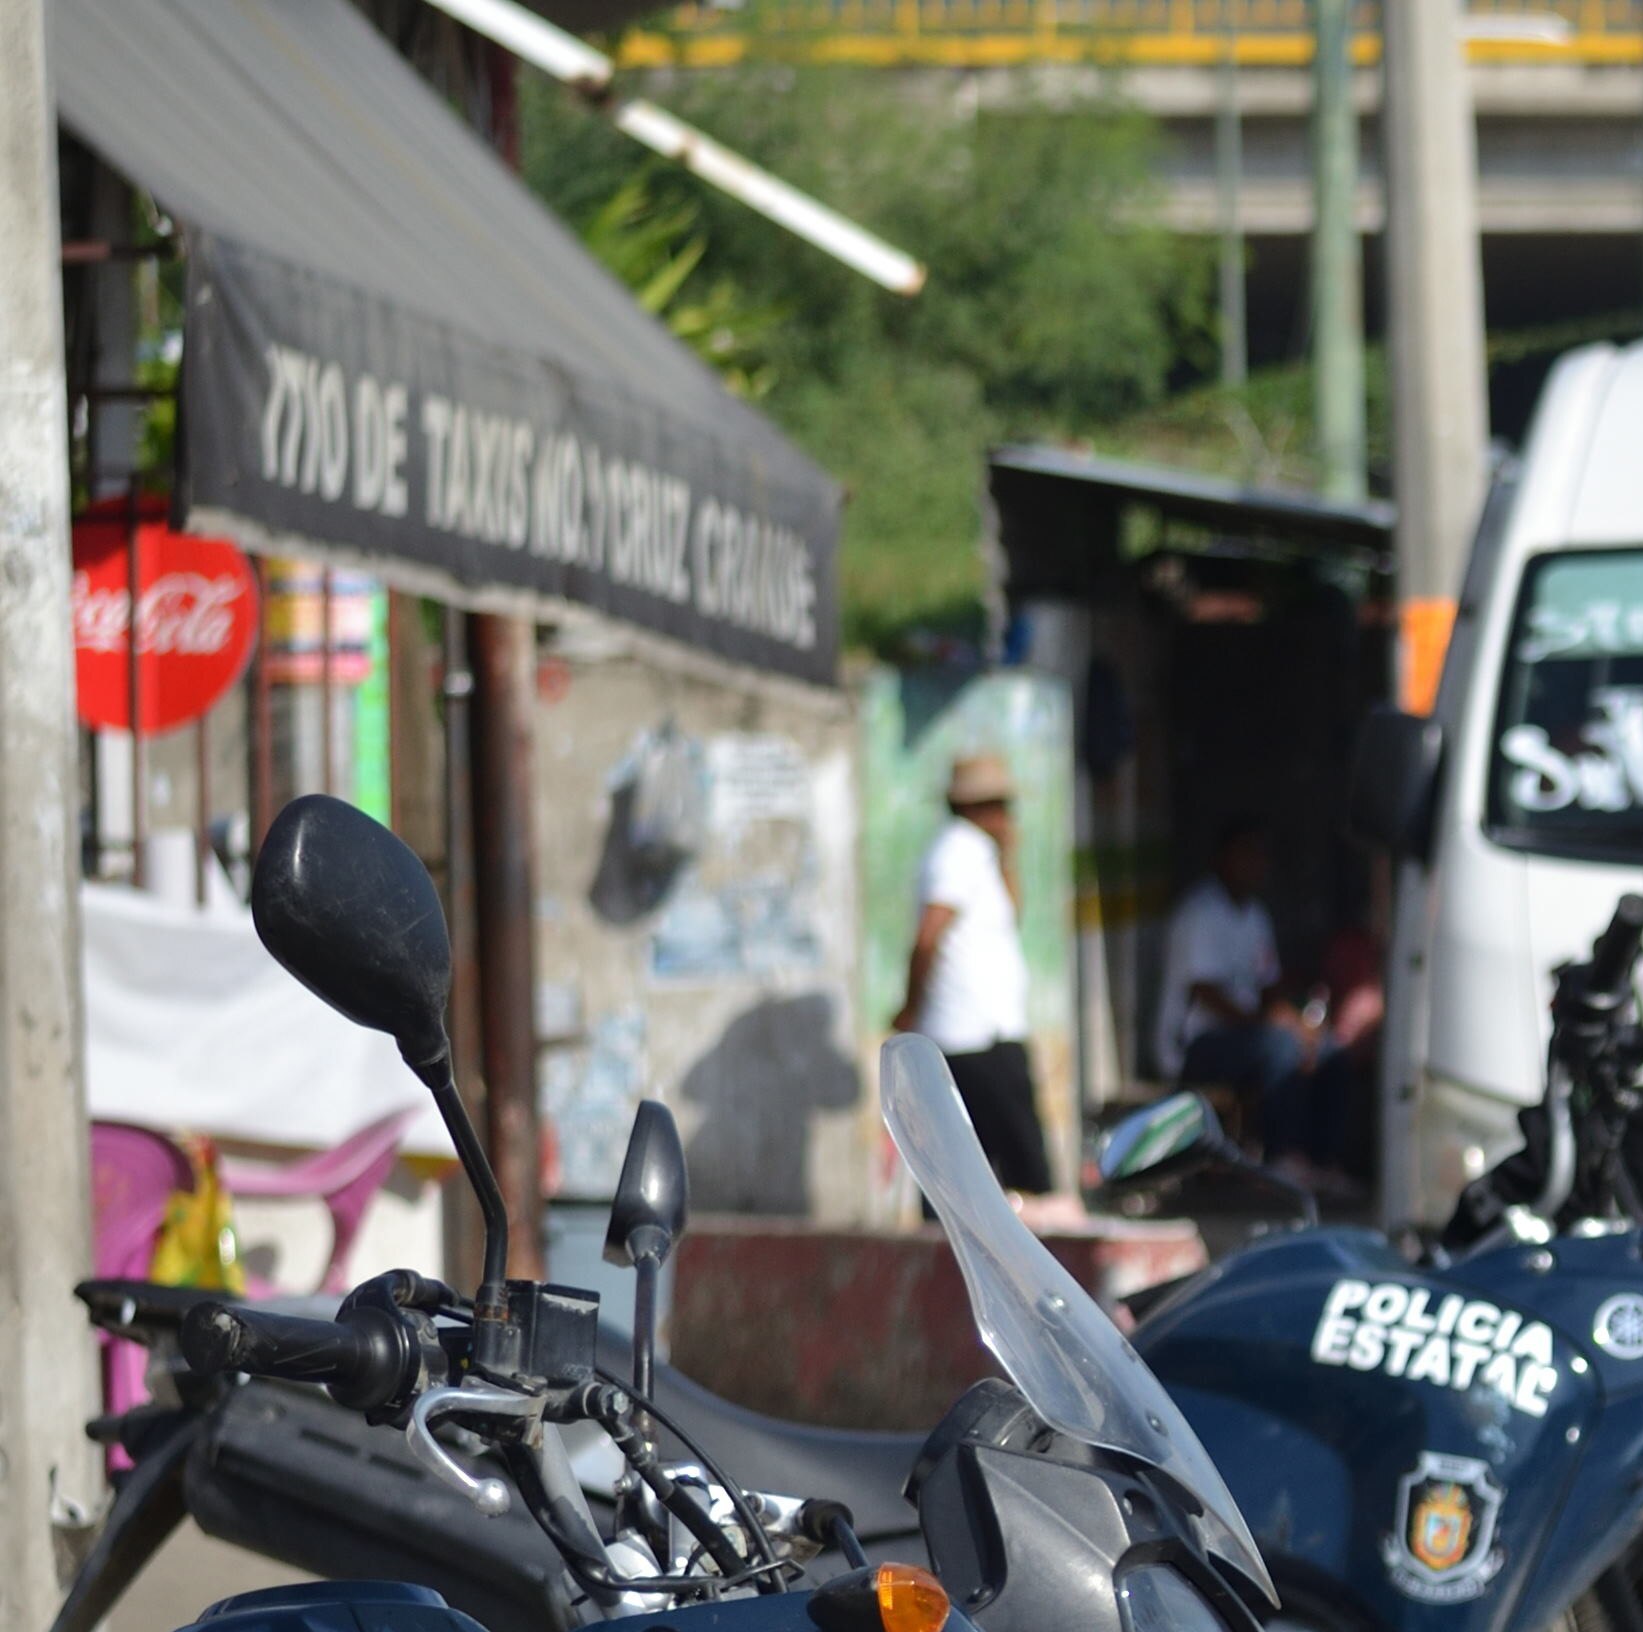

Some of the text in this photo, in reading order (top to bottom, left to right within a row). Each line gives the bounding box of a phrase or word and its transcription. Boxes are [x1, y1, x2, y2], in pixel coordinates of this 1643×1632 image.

[353, 372, 408, 518] DE
[421, 392, 534, 549] TAXIS
[1311, 1317, 1559, 1418] ESTATAL
[1325, 1279, 1556, 1367] POLICIA
